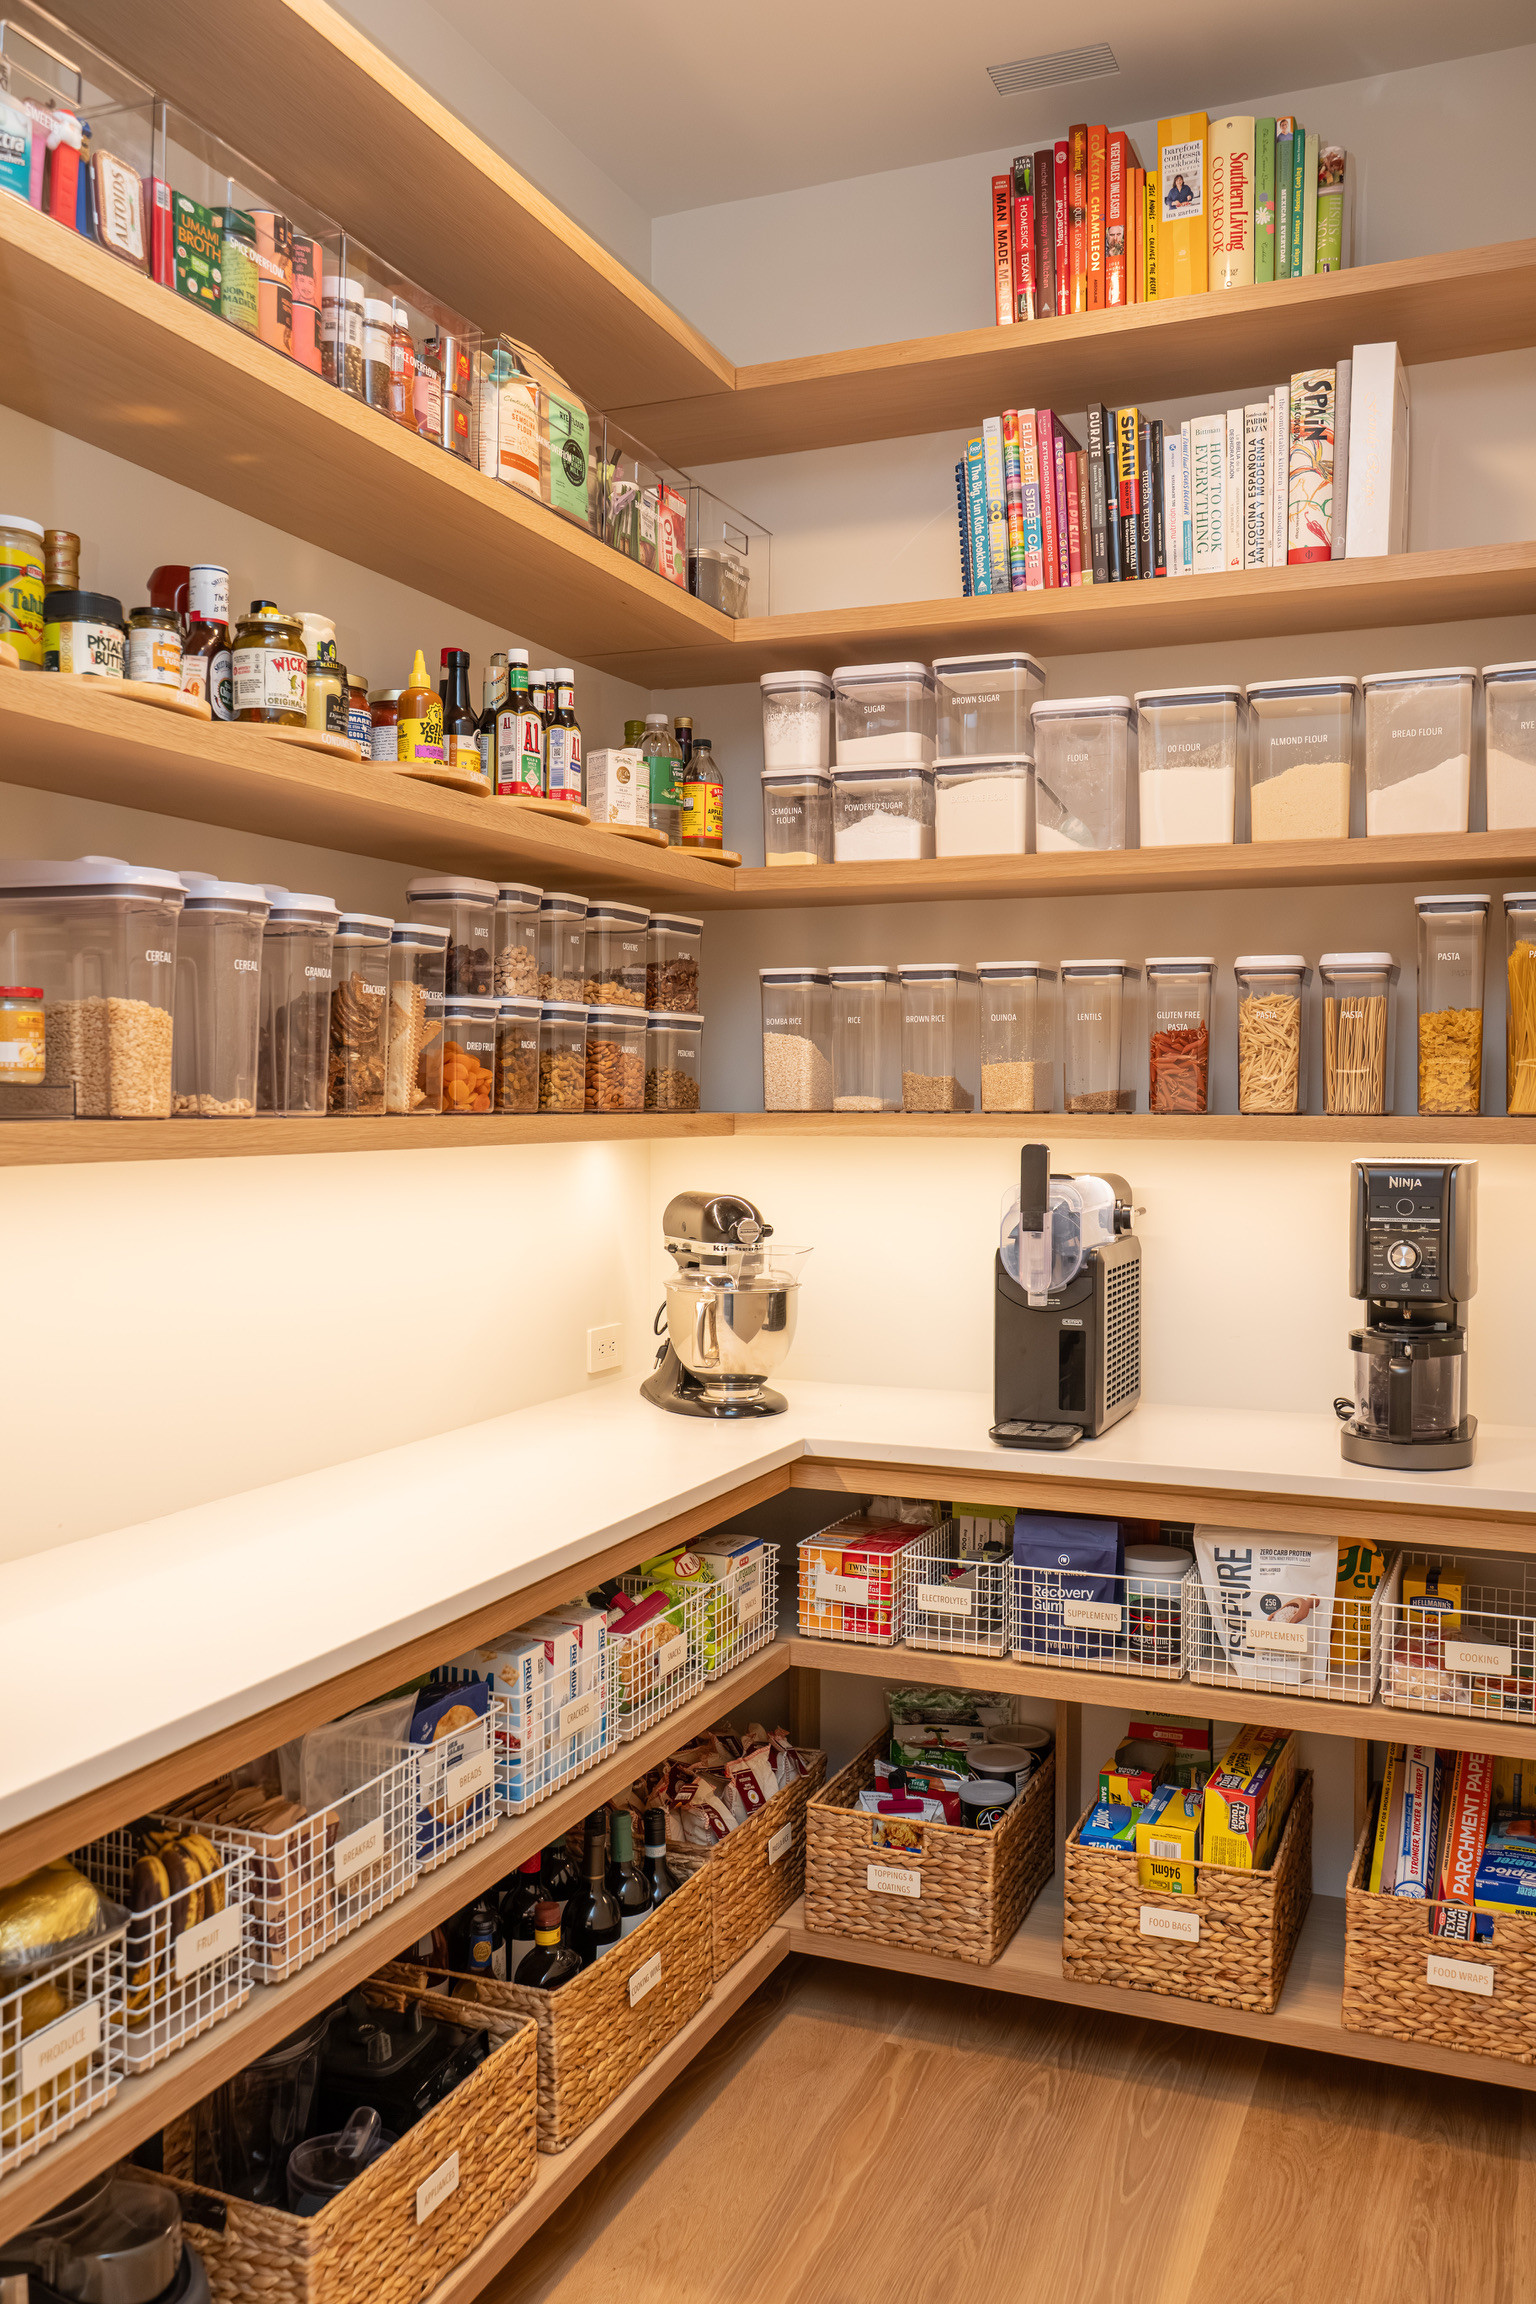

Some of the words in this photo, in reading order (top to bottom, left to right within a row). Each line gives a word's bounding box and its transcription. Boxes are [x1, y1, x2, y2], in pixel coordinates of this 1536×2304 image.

[1164, 143, 1201, 156] barefoot
[1164, 150, 1201, 163] contessa
[1090, 134, 1105, 193] COCKTAIL
[1110, 141, 1120, 182] VEGETABLES
[1164, 157, 1201, 170] cookbook
[1229, 152, 1249, 211] Southern
[112, 171, 130, 246] ALTOIDS
[996, 193, 1007, 222] MAN
[1109, 182, 1120, 220] UNLEASHED
[1212, 156, 1225, 256] COOKBOOK
[181, 214, 219, 247] UMAMI
[1020, 204, 1029, 249] HOMESICK
[1055, 199, 1064, 247] MasterChef
[1226, 211, 1249, 252] Living
[1090, 196, 1101, 271] CHAMELEON
[178, 226, 221, 263] BROTH
[997, 230, 1009, 266] MADE
[230, 236, 250, 258] SPICE
[250, 252, 285, 279] OVERFLOW
[1021, 252, 1030, 282] TEXAN
[410, 356, 438, 380] OVERFLOW
[512, 413, 535, 430] SEMOLINA
[559, 410, 569, 423] RYE
[571, 416, 584, 431] FLOUR
[1246, 417, 1268, 426] PARDO
[517, 424, 533, 437] FLOUR
[1195, 428, 1221, 436] Bittman
[1277, 413, 1285, 455] comfortable
[1022, 422, 1034, 485] ELIZABETH
[1121, 415, 1135, 477] SPAIN
[987, 436, 1000, 498] BASQUE
[1210, 442, 1222, 478] HOW
[1247, 438, 1257, 498] ESPAÑOLA
[1256, 437, 1265, 496] MODERNA
[971, 463, 982, 481] The
[1042, 441, 1051, 504] EXTRAORDINARY
[1142, 469, 1151, 506] vegana
[1211, 485, 1222, 505] TO
[973, 498, 983, 516] Fun
[1067, 491, 1077, 507] LA
[1195, 444, 1209, 554] EVERYTHING
[1256, 501, 1265, 509] Y
[1025, 488, 1036, 531] STREET
[974, 515, 984, 535] Kids
[1068, 509, 1079, 554] PAELLA
[1142, 508, 1151, 543] Cocina
[1210, 508, 1222, 553] COOK
[1248, 502, 1257, 545] COCINA
[990, 499, 1005, 572] COUNTRY
[1045, 506, 1053, 562] CELEBRATIONS
[1256, 512, 1265, 563] ANTIGUA
[975, 535, 987, 578] Cookbook
[1248, 550, 1257, 564] LA
[268, 697, 302, 709] ORIGINAL
[951, 695, 977, 706] BROWN
[978, 693, 1000, 704] SUGAR
[863, 704, 886, 714] SUGAR
[1391, 728, 1416, 739] BREAD
[1418, 726, 1443, 737] FLOUR
[1520, 720, 1535, 730] RYE
[1178, 742, 1201, 752] FLOUR
[1270, 735, 1302, 746] ALMOND
[1303, 733, 1328, 744] FLOUR
[1066, 752, 1089, 763] FLOUR
[771, 806, 803, 817] SEMOLINA
[844, 802, 879, 812] POWDERED
[880, 800, 903, 811] SUGAR
[776, 815, 796, 825] FLOUR
[474, 926, 489, 938] DATES
[525, 927, 535, 938] NUTS
[570, 935, 580, 945] NUTS
[622, 942, 638, 952] CASHEWS
[146, 950, 172, 964] CEREAL
[234, 959, 258, 972] CEREAL
[1437, 952, 1460, 962] PASTA
[305, 966, 331, 979] GRANOLA
[362, 983, 386, 996] CRACKERS
[419, 989, 443, 1000] CRACKERS
[766, 1017, 787, 1026] BOMBA
[788, 1016, 802, 1026] RICE
[847, 1015, 861, 1025] RICE
[905, 1015, 929, 1024] BROWN
[930, 1014, 945, 1023] RICE
[990, 1013, 1017, 1023] QUINOA
[1077, 1012, 1102, 1022] LENTILS
[1156, 1010, 1182, 1020] GLUTEN
[1184, 1010, 1201, 1020] FREE
[1256, 1010, 1277, 1020] PASTA
[1341, 1010, 1363, 1019] PASTA
[1167, 1022, 1188, 1032] PASTA
[466, 1041, 481, 1051] DRIED
[521, 1040, 537, 1050] RAISINS
[571, 1043, 581, 1052] NUTS
[1260, 1548, 1273, 1556] ZERO
[1273, 1549, 1288, 1557] CARB
[1288, 1550, 1312, 1558] PROTEIN
[835, 1583, 847, 1593] TEA
[1033, 1585, 1095, 1602] Recovery
[744, 1597, 758, 1611] SNACKS
[921, 1593, 968, 1606] ELECTROLYTES
[1412, 1599, 1451, 1610] HELLMANN'S
[1067, 1608, 1118, 1622] SUPPLEMENTS
[1250, 1628, 1305, 1643] SUPPLEMENTS
[667, 1646, 682, 1662] SNACKS
[1459, 1652, 1499, 1665] COOKING
[566, 1702, 590, 1725] CRACKERS
[459, 1766, 482, 1788] BREADS
[1415, 1768, 1424, 1800] HEAVIER?
[1091, 1808, 1111, 1830] Ziploc
[1231, 1803, 1239, 1830] TOUGH
[1238, 1805, 1246, 1830] TEXAS
[1412, 1809, 1422, 1837] THICKER
[1426, 1806, 1440, 1891] ALUMINUM
[1433, 1767, 1442, 1797] FOIL
[343, 1834, 377, 1866] BREAKFAST
[1453, 1793, 1480, 1897] PARCHMENT
[1410, 1838, 1420, 1875] STRONGER,
[873, 1868, 908, 1882] TOPPINGS
[908, 1874, 914, 1882] &
[1151, 1863, 1181, 1880] 946mL
[877, 1881, 911, 1894] COATINGS
[1148, 1916, 1170, 1929] FOOD
[1171, 1921, 1193, 1933] BAGS
[196, 1929, 219, 1951] FRUIT
[631, 1973, 649, 1998] COOKING
[649, 1962, 662, 1981] WINE
[1433, 1966, 1457, 1979] FOOD
[1459, 1971, 1489, 1985] WRAPS
[39, 2026, 86, 2070] PRODUCE
[423, 2166, 456, 2208] APPLIANCES
